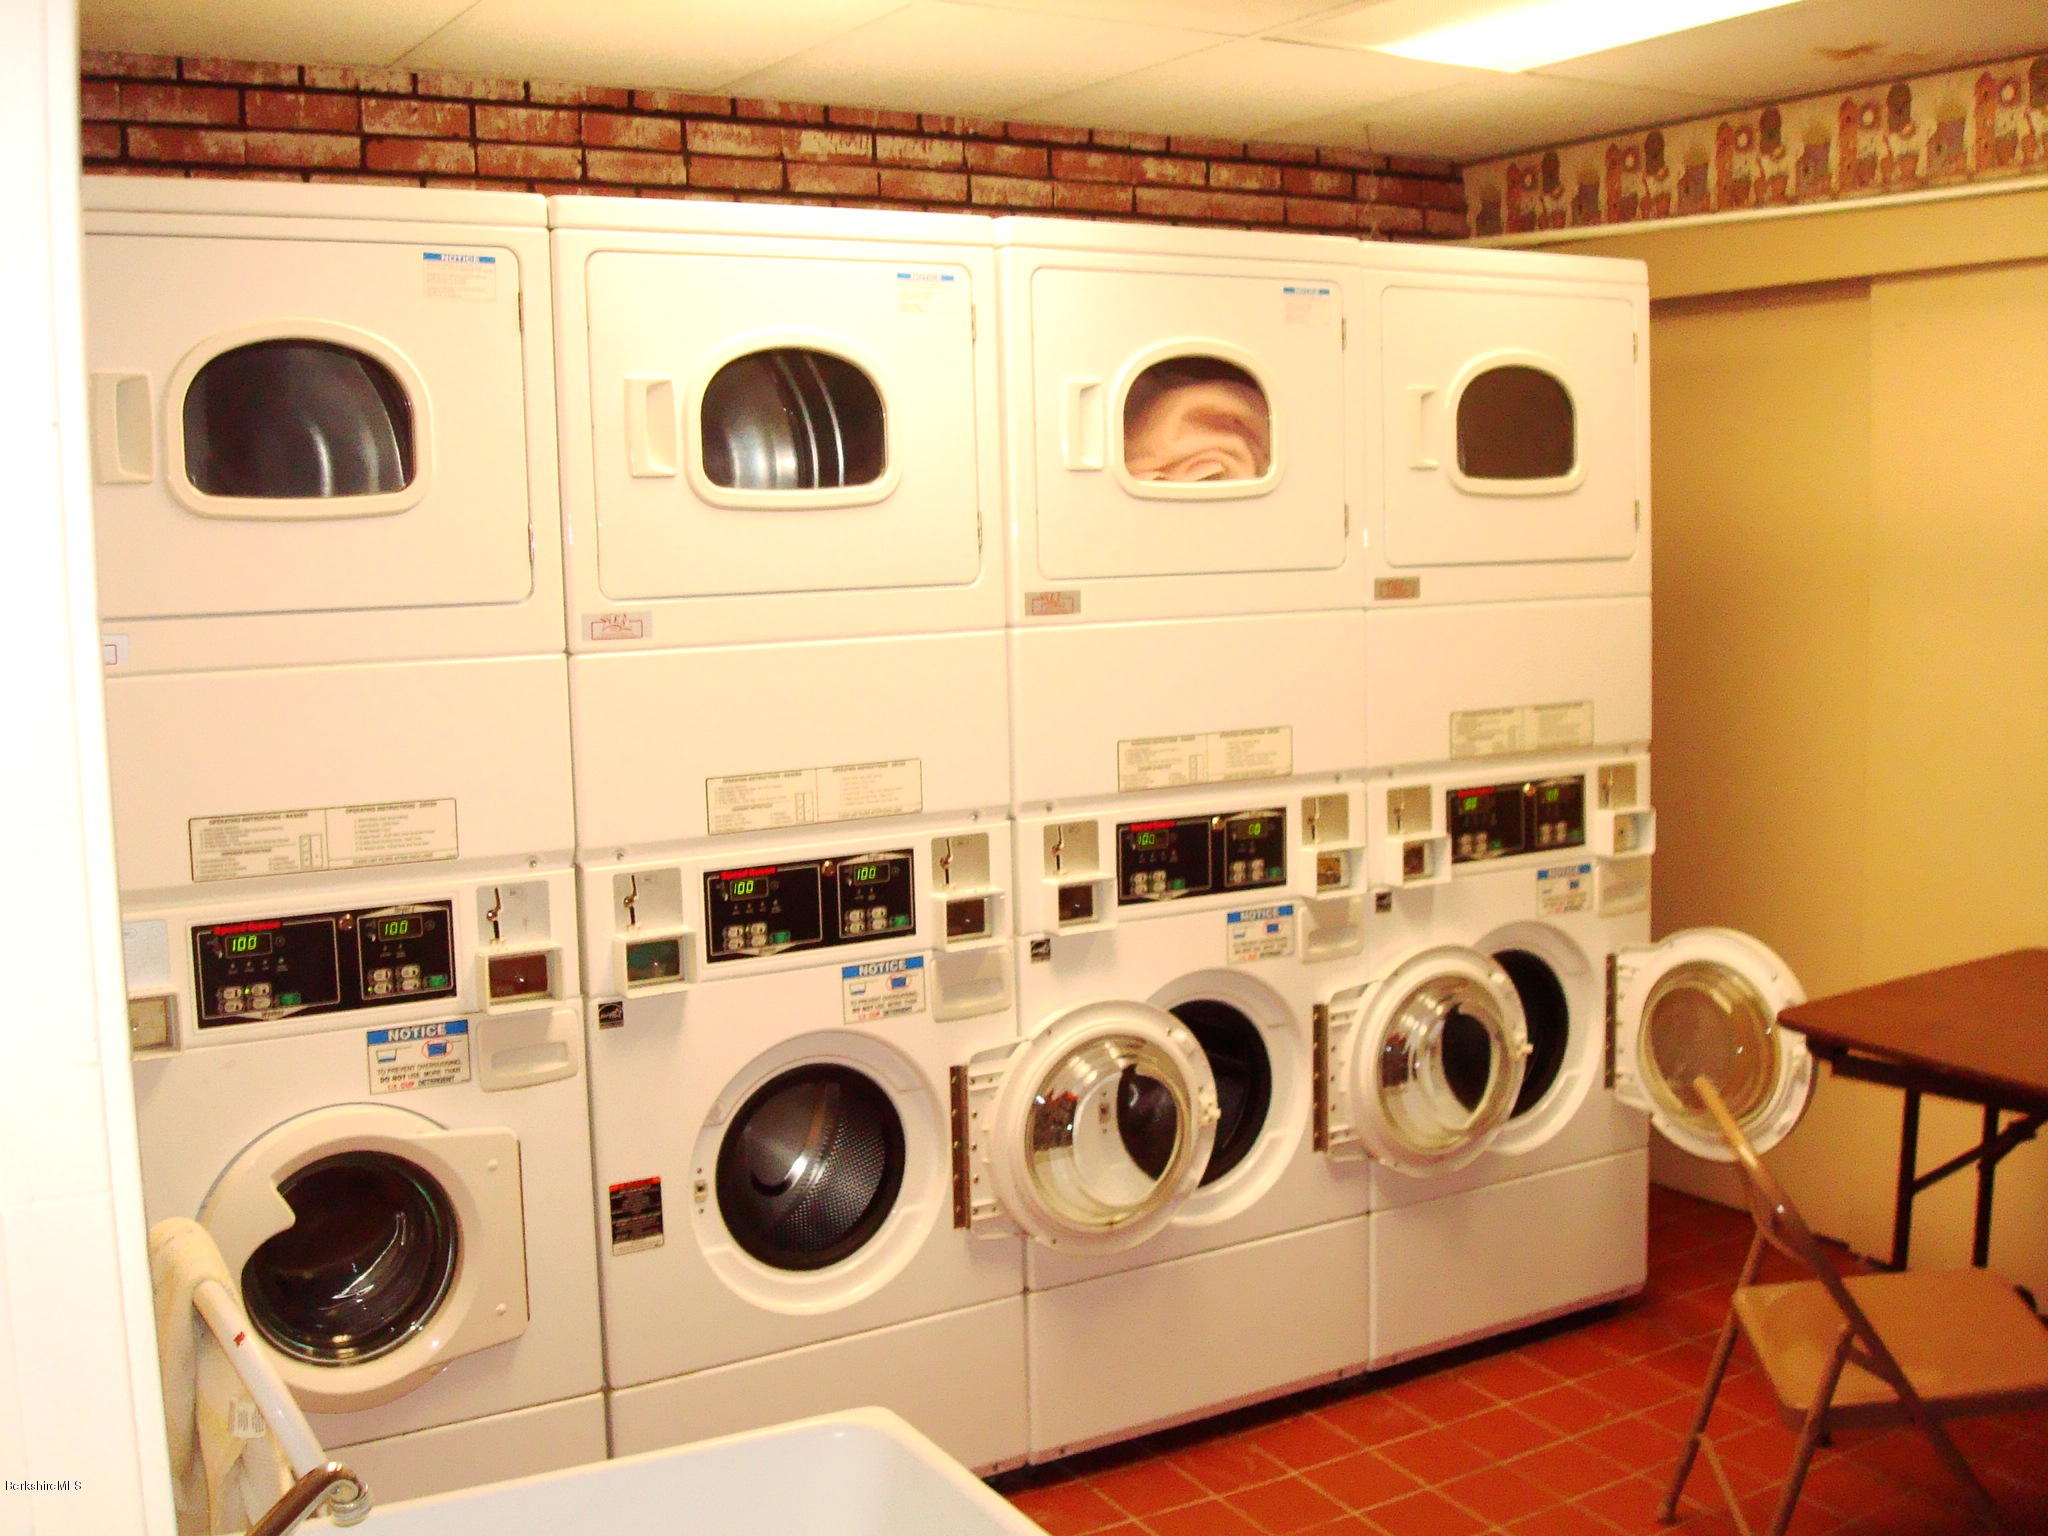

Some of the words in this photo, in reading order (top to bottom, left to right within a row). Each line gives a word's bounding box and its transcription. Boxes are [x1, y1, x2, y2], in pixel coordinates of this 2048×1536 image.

[856, 865, 878, 881] 100
[733, 879, 754, 895] 100
[384, 919, 409, 936] 100
[231, 935, 258, 952] 100
[858, 959, 907, 977] NOTICE
[387, 1023, 446, 1042] NOTICE
